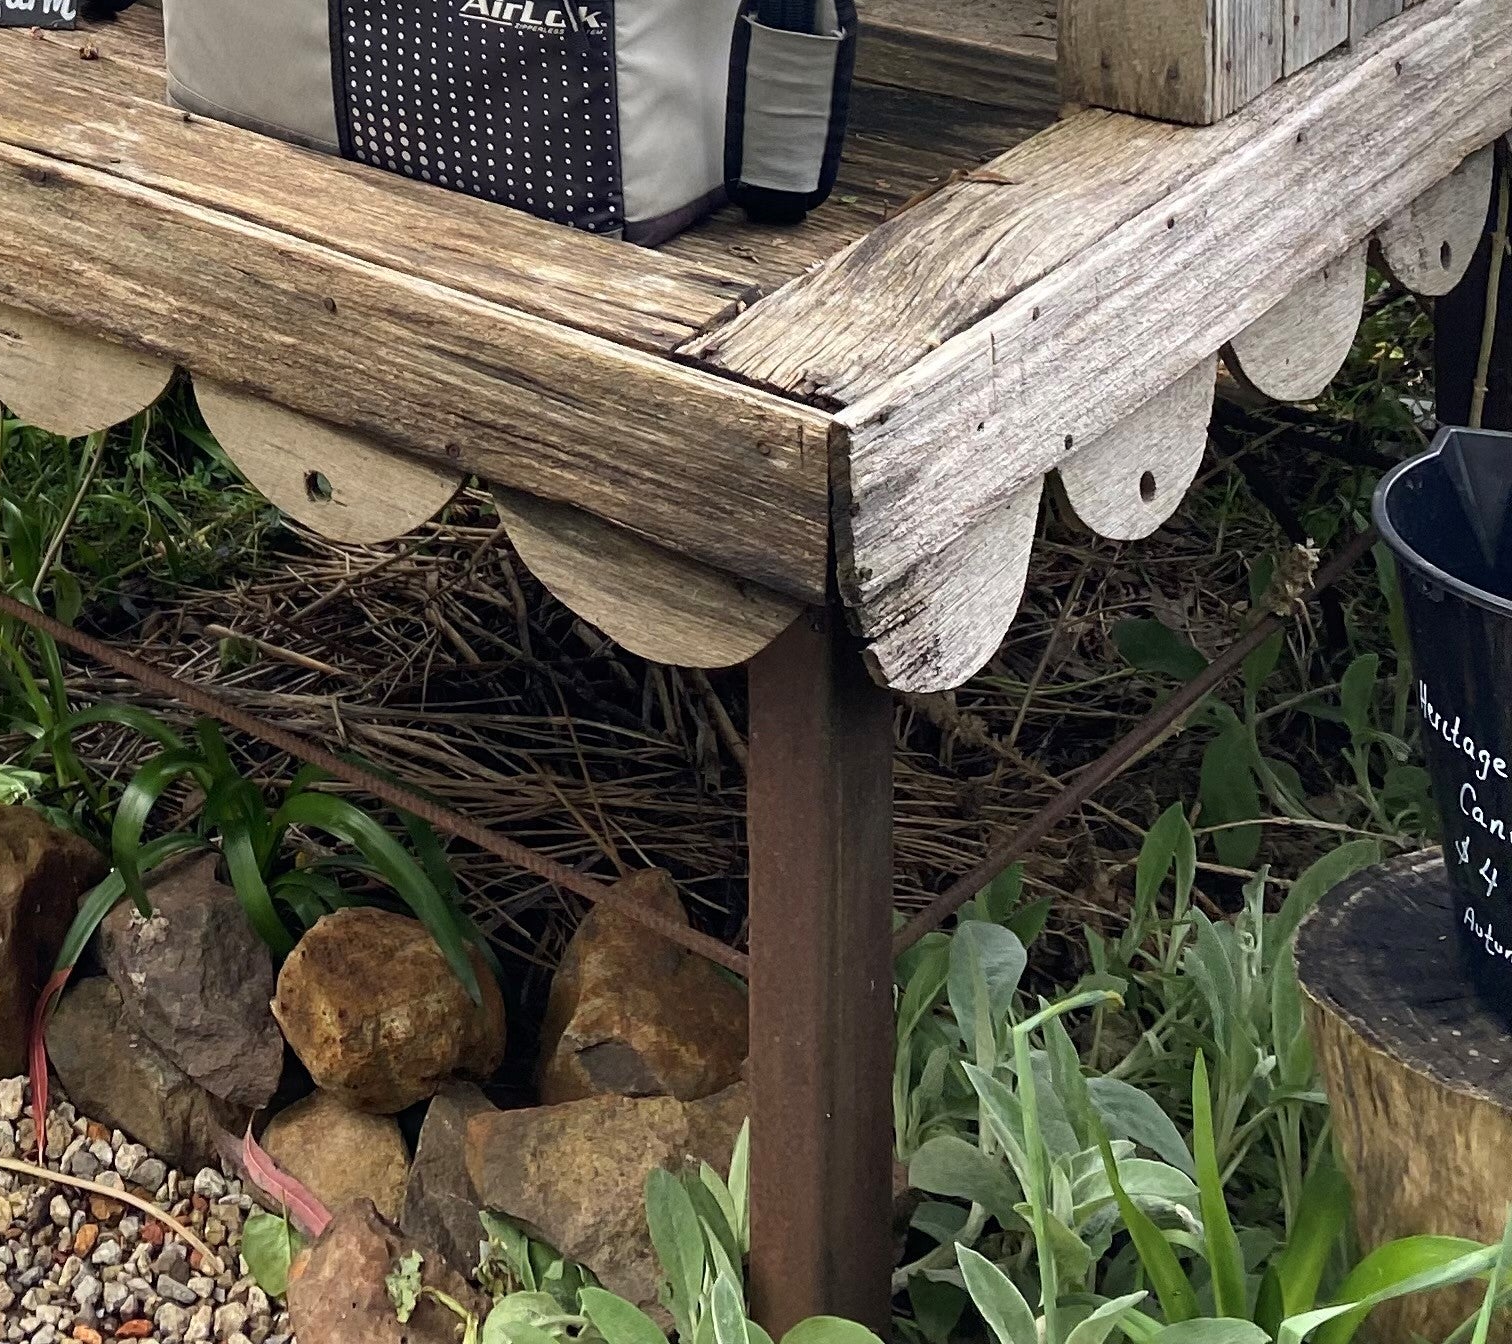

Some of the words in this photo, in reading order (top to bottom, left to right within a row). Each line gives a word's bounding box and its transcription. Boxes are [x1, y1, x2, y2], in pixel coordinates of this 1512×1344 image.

[514, 22, 565, 36] ZIPPERLESS
[1419, 679, 1509, 781] Heritage
[1459, 782, 1512, 845] Can
